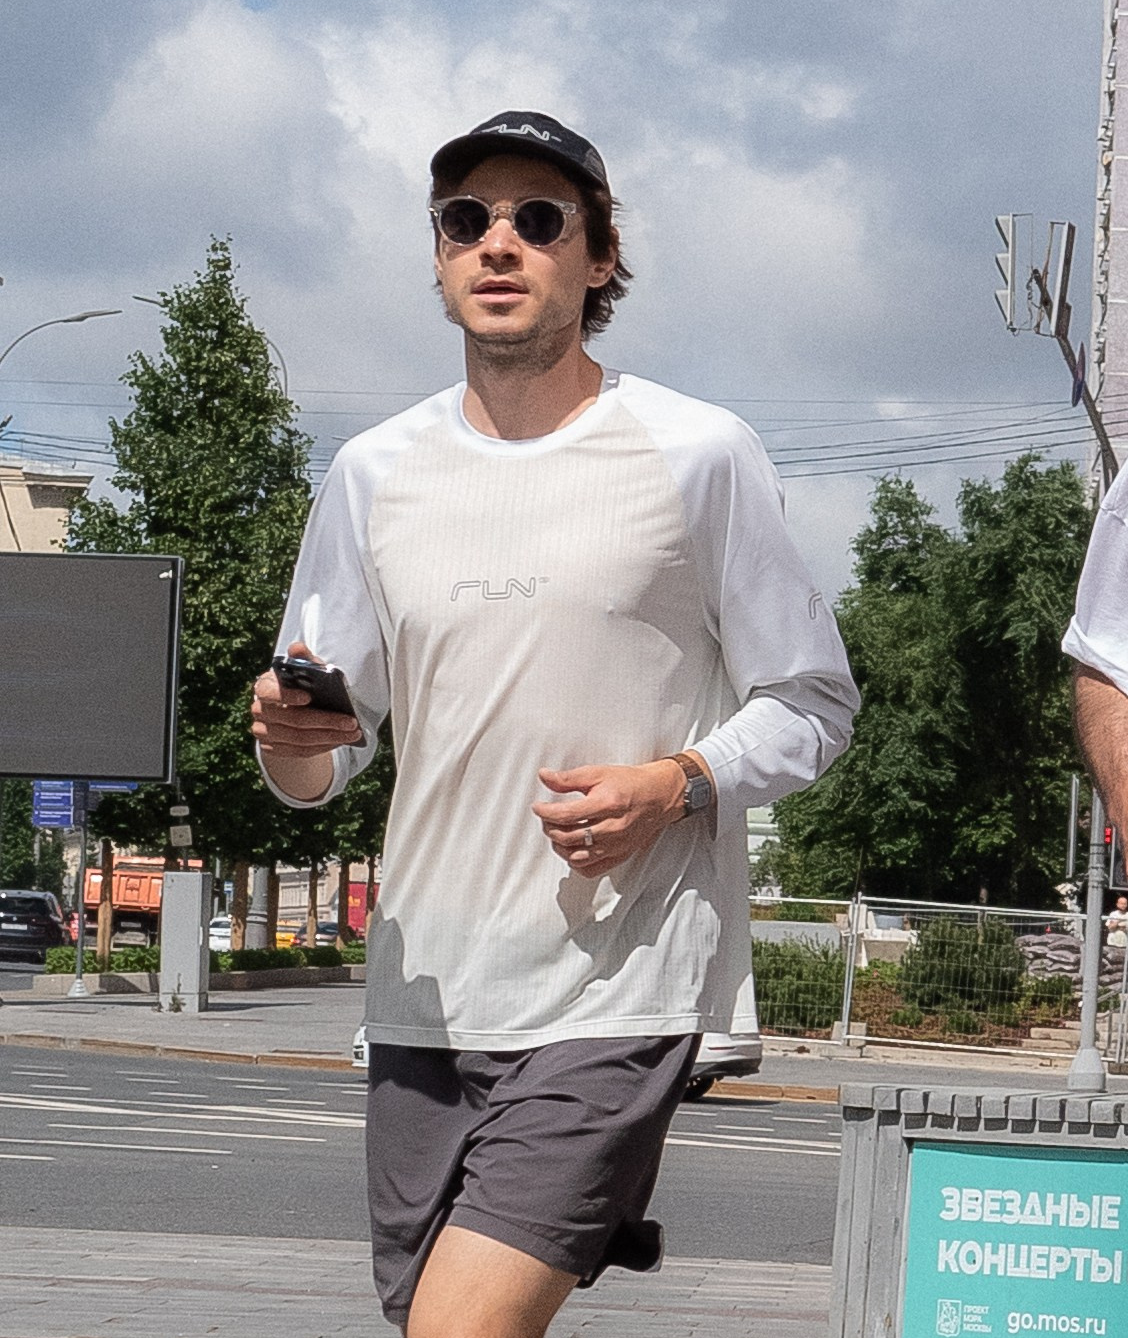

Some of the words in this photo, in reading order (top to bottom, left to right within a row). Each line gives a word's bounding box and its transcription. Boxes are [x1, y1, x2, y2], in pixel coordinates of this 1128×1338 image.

[939, 1186, 1122, 1230] ЗВЕЗДНЫЕ
[937, 1239, 1123, 1285] КОНЦЕРТЫ
[1007, 1311, 1106, 1335] go.mos.ru
